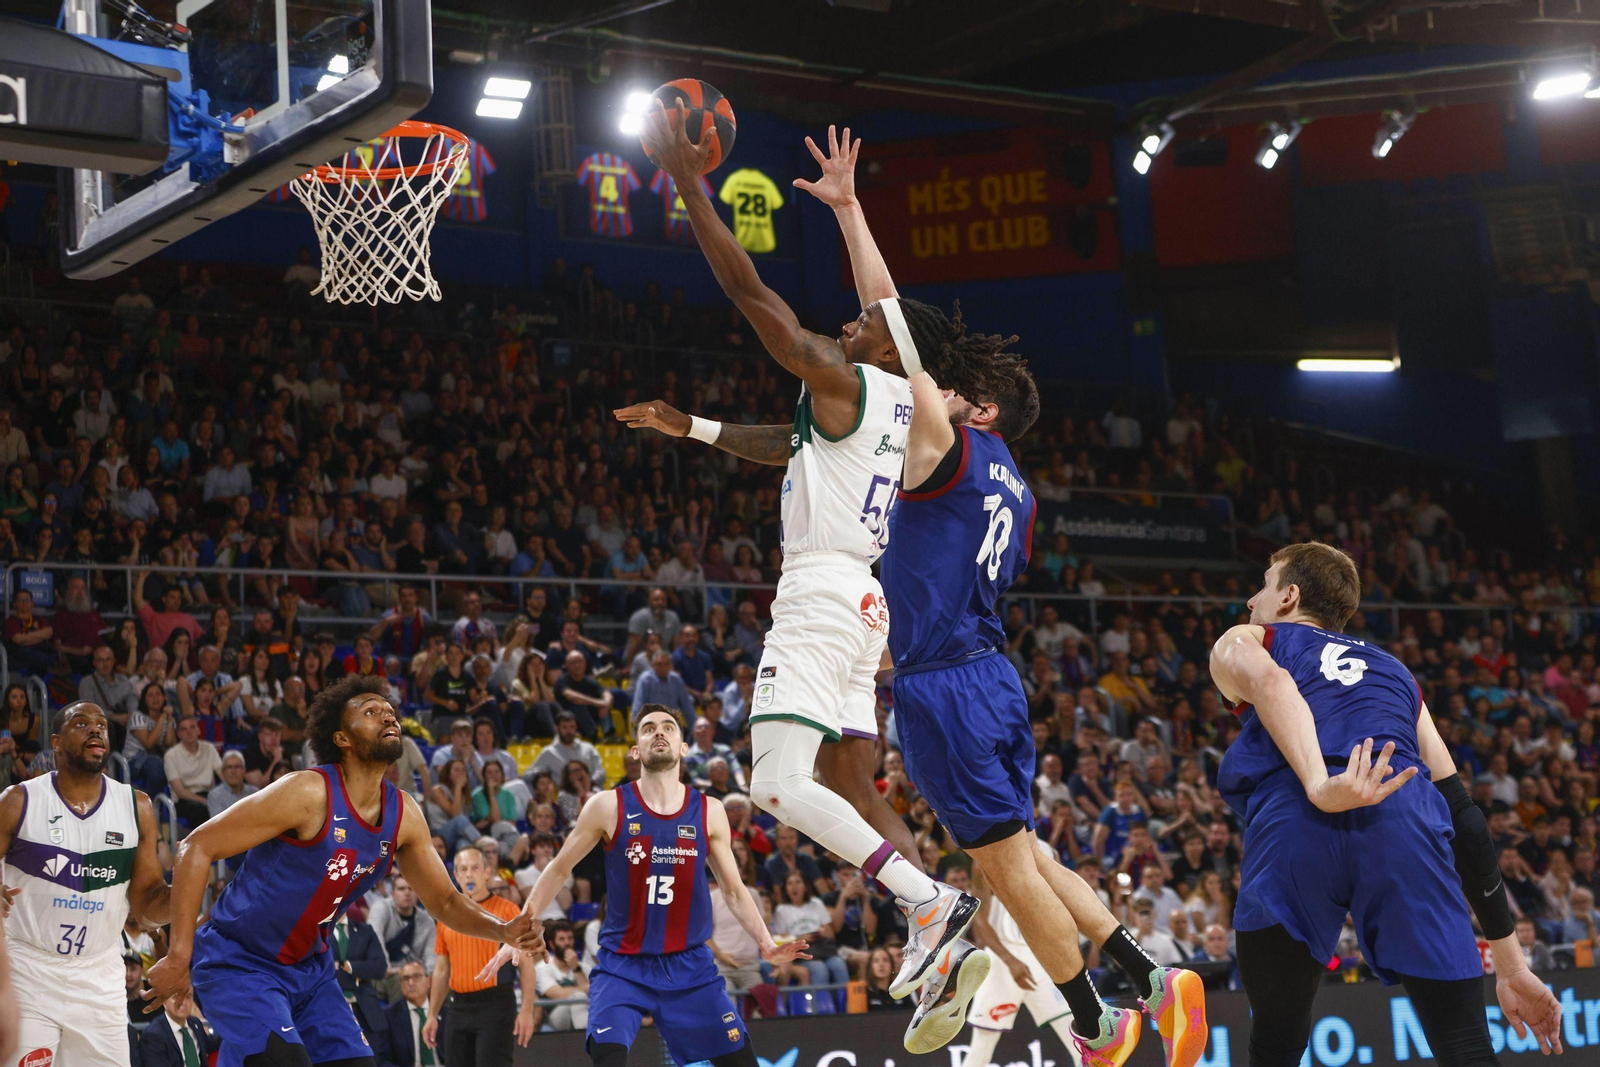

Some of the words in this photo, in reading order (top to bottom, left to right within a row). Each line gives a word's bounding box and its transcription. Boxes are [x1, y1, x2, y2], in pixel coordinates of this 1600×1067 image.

[600, 175, 619, 203] 4
[907, 167, 970, 216] MÉS
[979, 170, 1048, 216] QUE
[736, 192, 768, 218] 28
[910, 222, 958, 258] UN
[968, 214, 1049, 252] CLUB
[989, 462, 1025, 504] KALINIC
[975, 493, 1013, 581] 10
[1319, 642, 1369, 686] 6
[651, 846, 699, 857] Assistència
[651, 855, 685, 865] Sanitària
[70, 863, 117, 882] Unicaja
[646, 875, 675, 905] 13
[56, 924, 87, 956] 34
